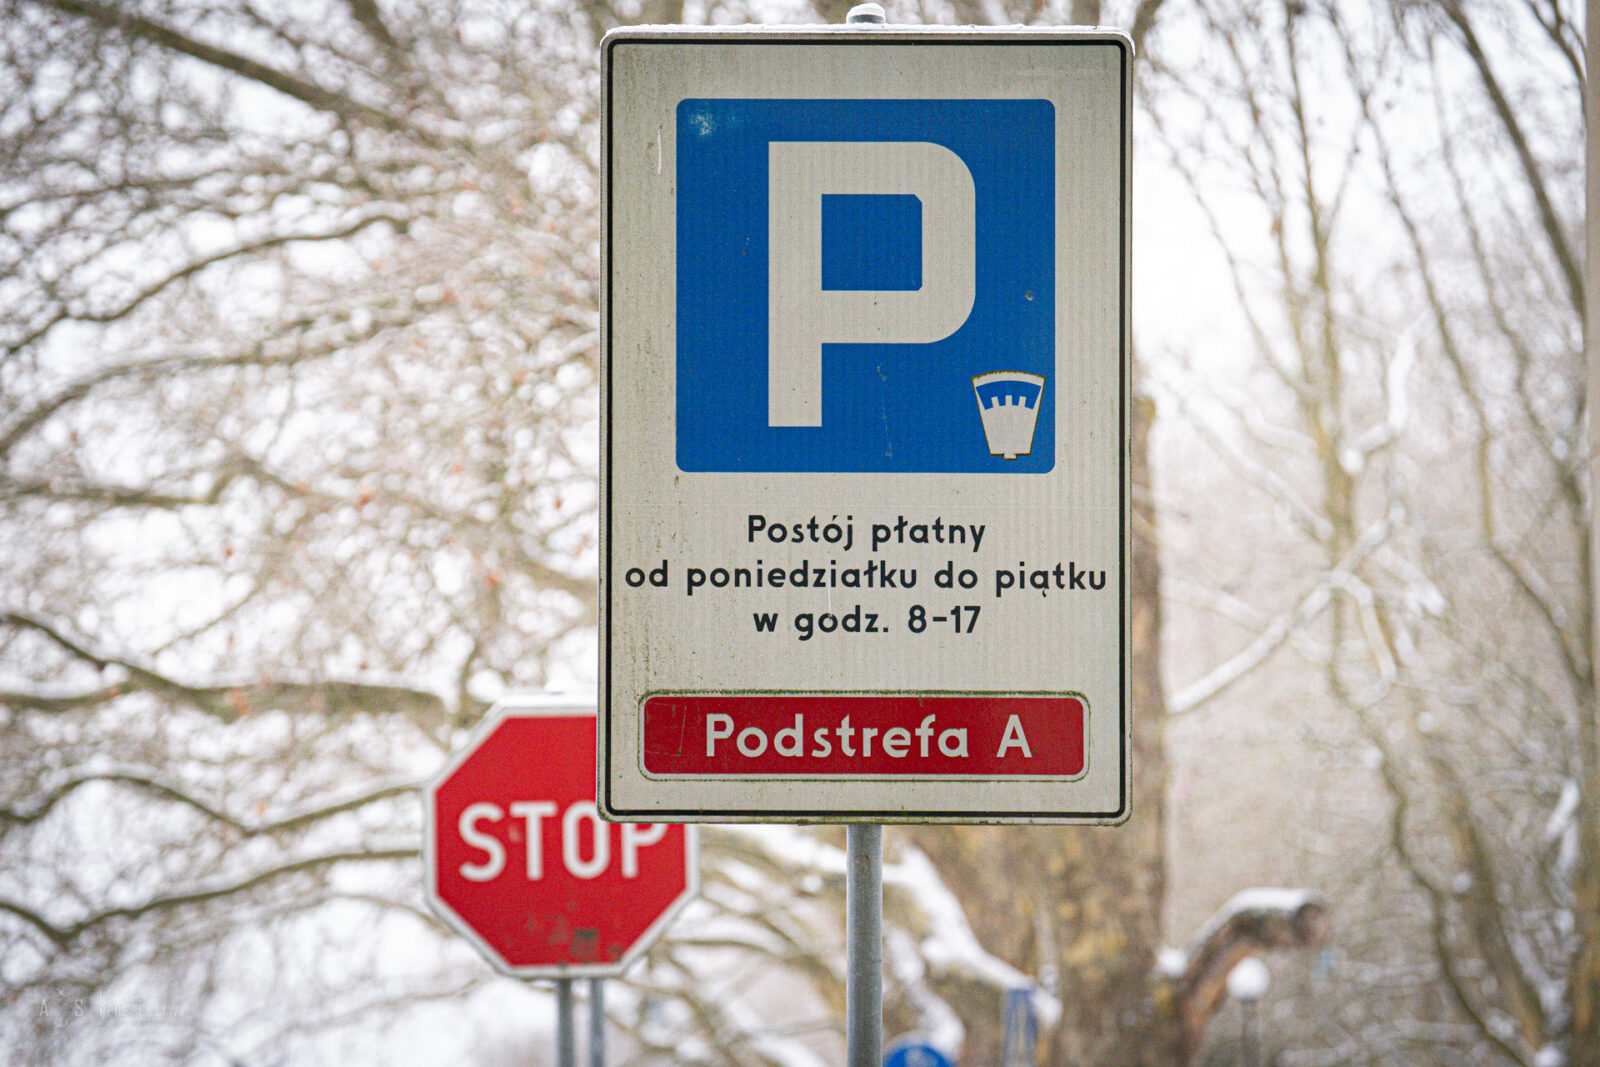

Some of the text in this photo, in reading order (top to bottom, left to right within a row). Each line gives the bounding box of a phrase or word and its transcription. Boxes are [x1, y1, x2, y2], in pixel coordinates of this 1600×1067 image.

[768, 141, 976, 427] P
[748, 514, 986, 553] Postój płatny
[625, 559, 1106, 598] od poniedziałku do piątku
[752, 604, 981, 642] w godz. 8-17
[706, 713, 1033, 758] Podstrefa A
[458, 801, 668, 881] STOP
